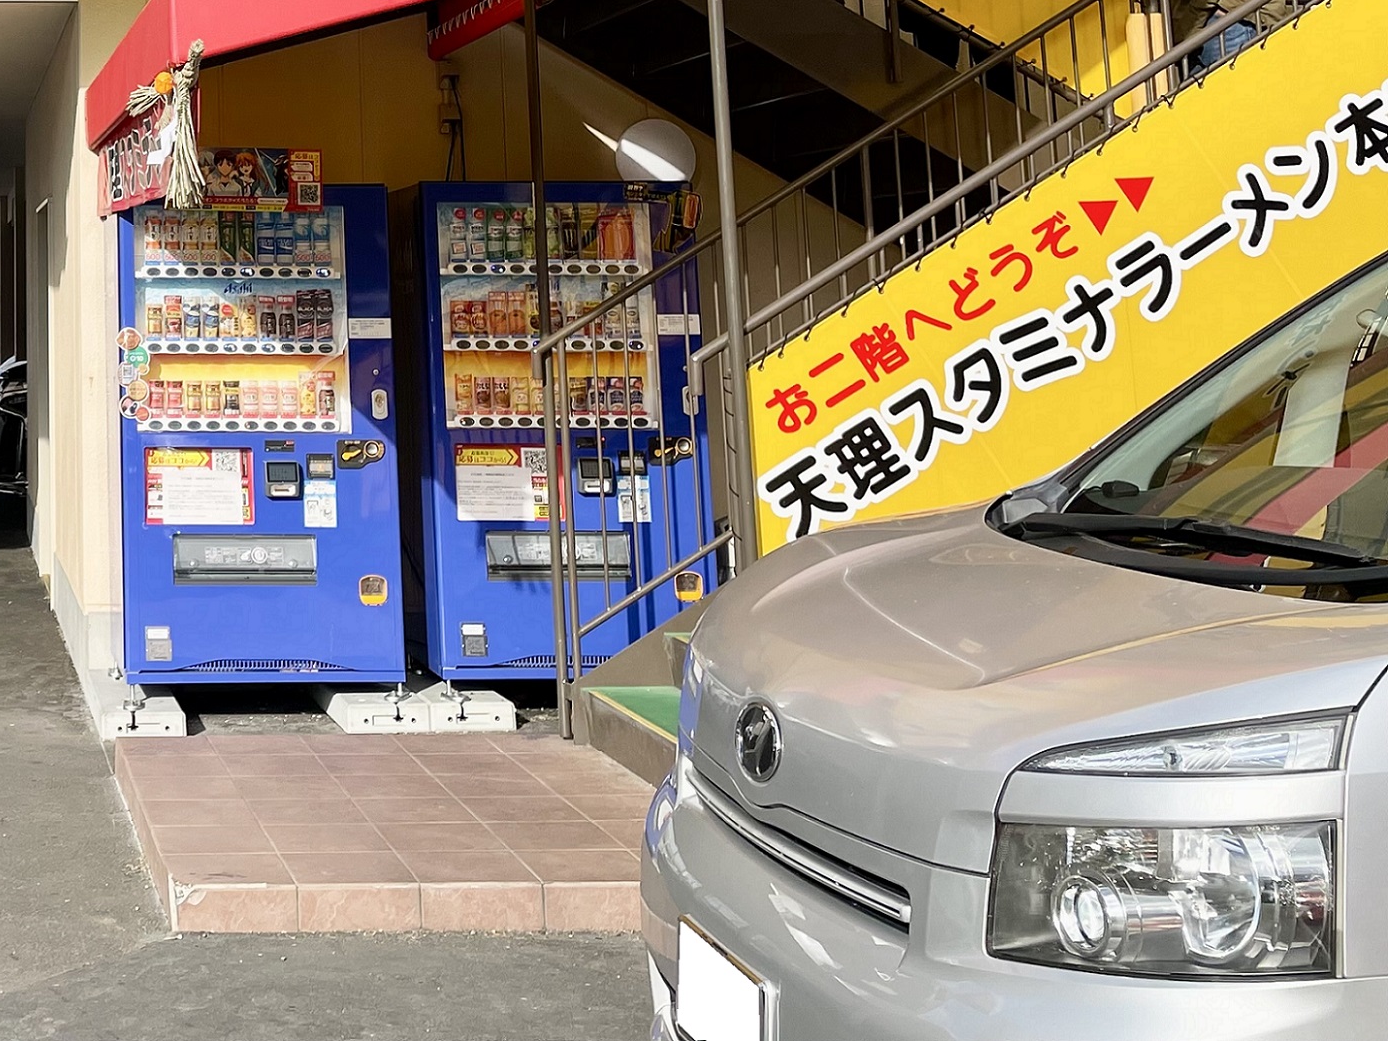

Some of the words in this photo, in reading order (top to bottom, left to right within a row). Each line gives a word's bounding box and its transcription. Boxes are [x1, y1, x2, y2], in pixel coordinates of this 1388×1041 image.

[223, 282, 253, 294] Asahi
[765, 211, 1079, 434] お二階へどうぞ
